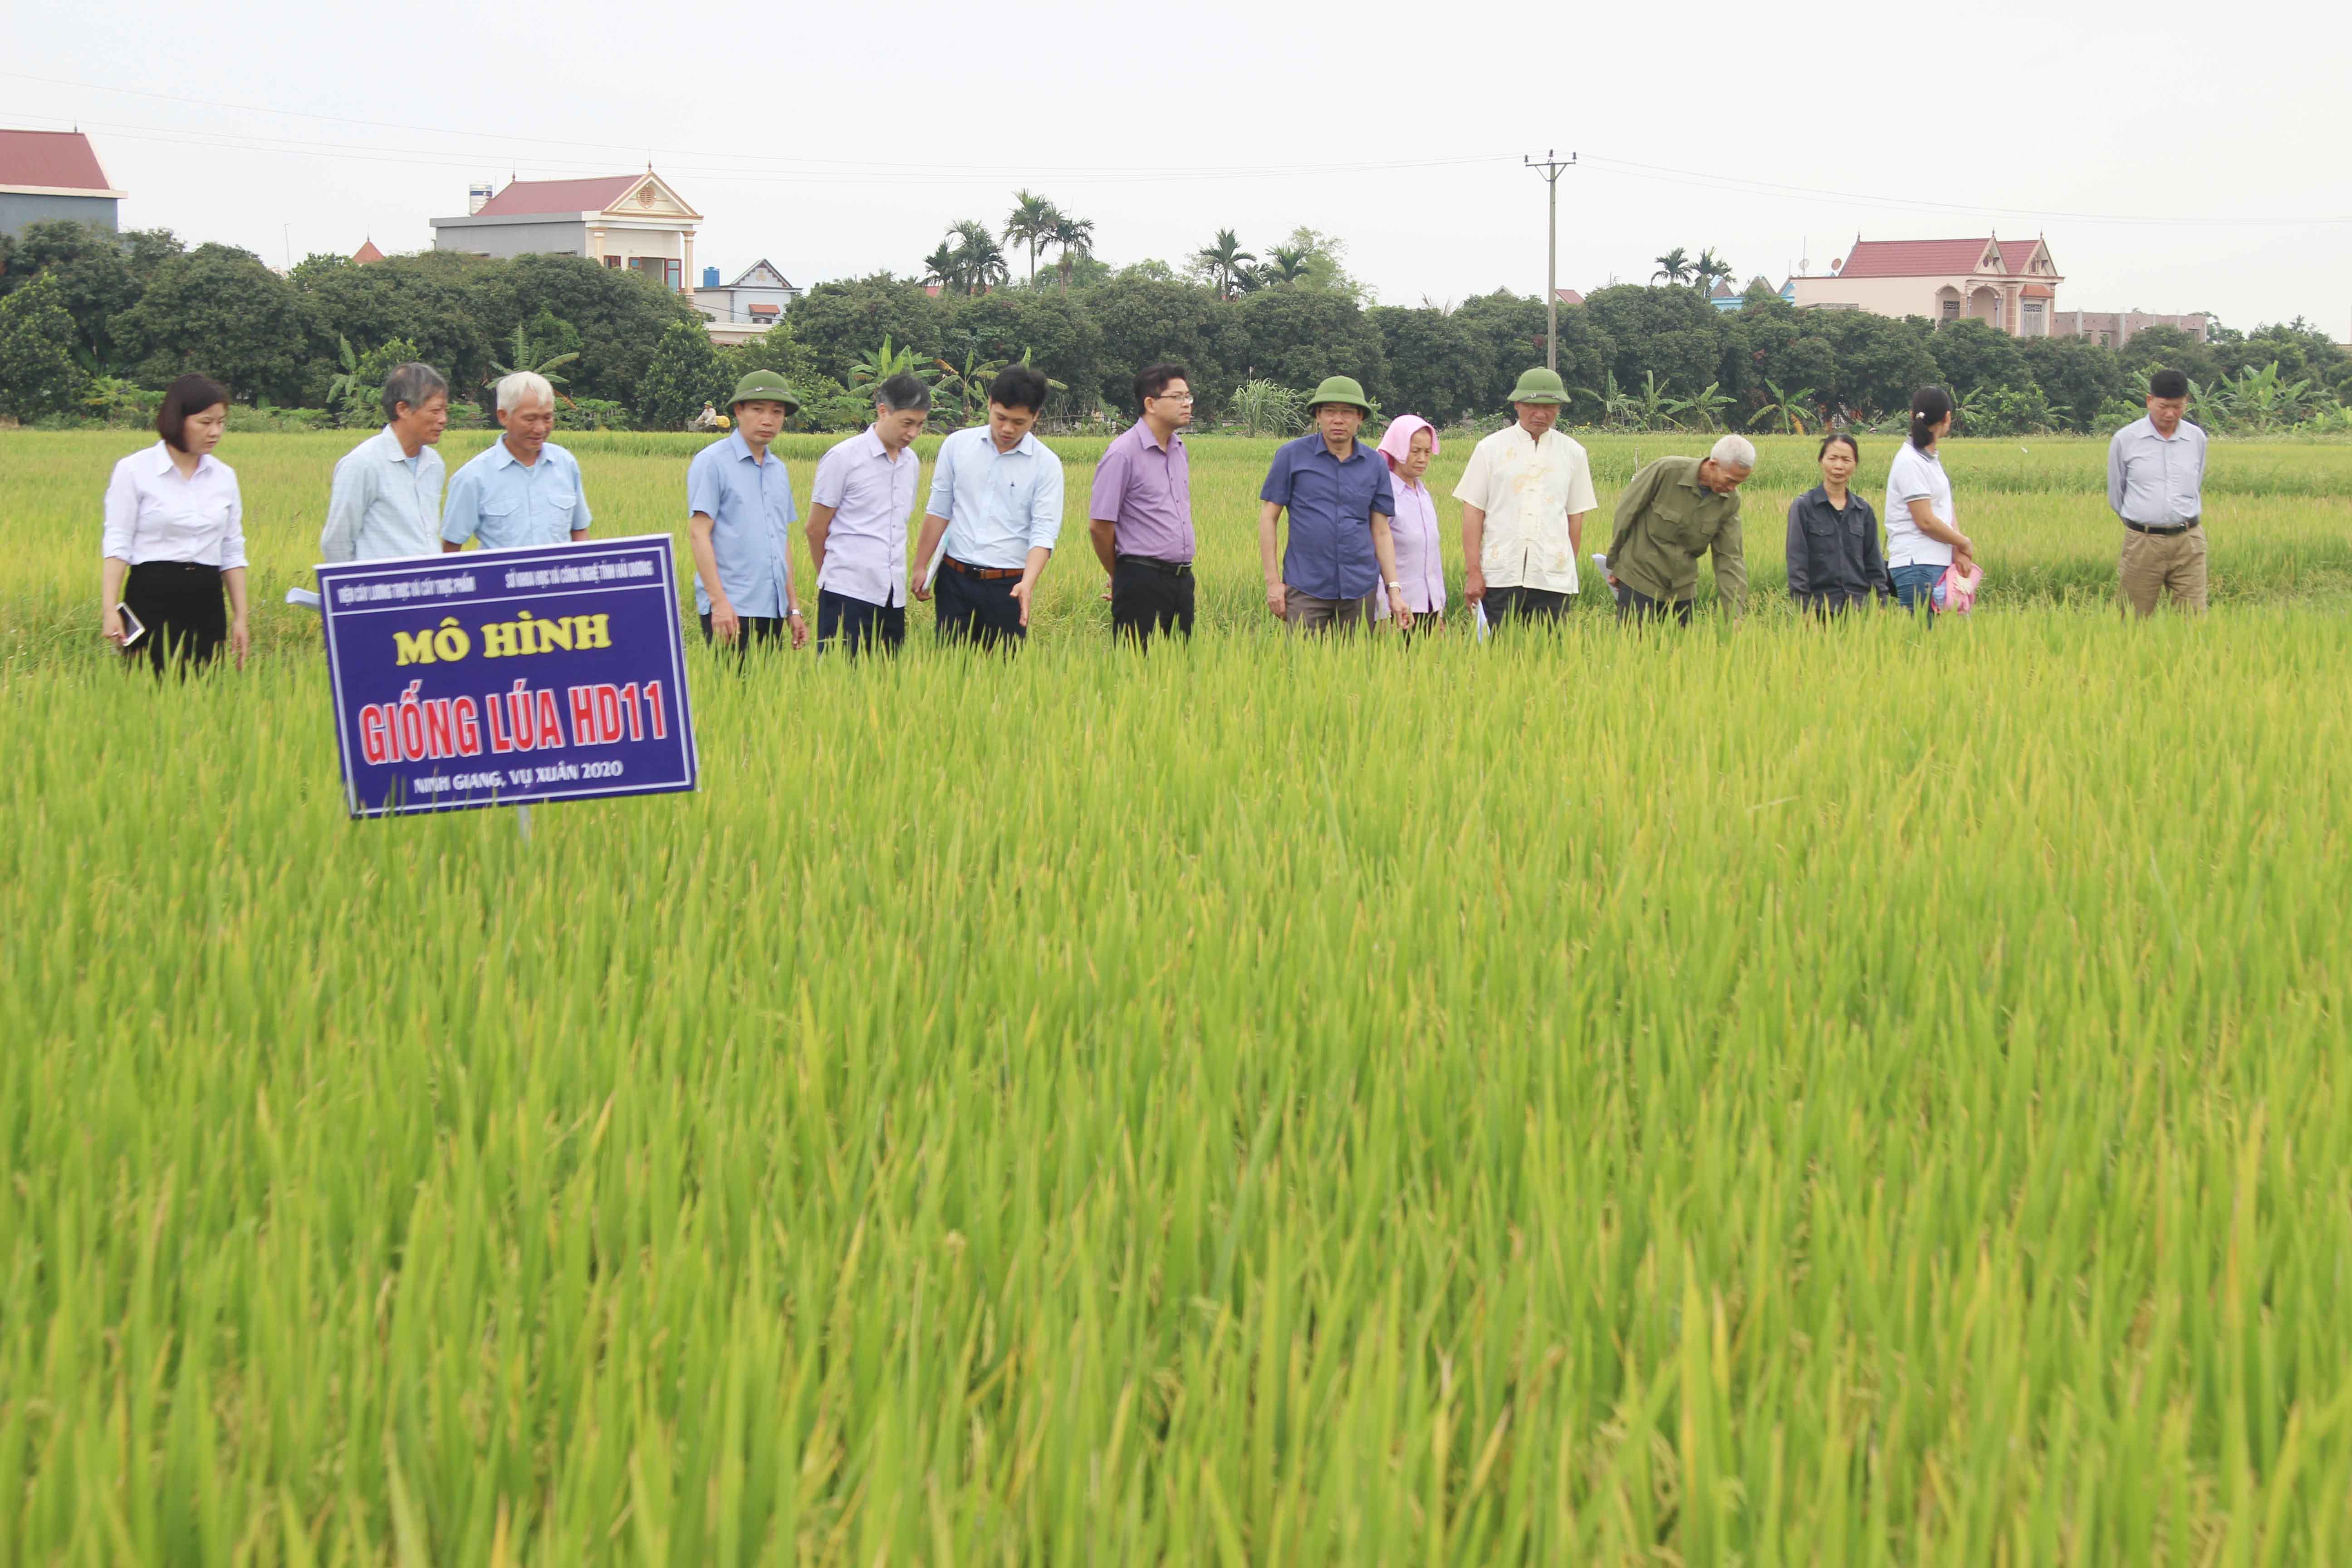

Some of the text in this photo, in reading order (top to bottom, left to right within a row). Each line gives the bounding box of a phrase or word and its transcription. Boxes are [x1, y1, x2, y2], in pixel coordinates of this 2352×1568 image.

[392, 610, 612, 666] MÔ HÌNH
[359, 678, 668, 765] GIỐNG LÚA HD11
[413, 759, 624, 794] NINH GIANG, VỤ XUÂN 2020
